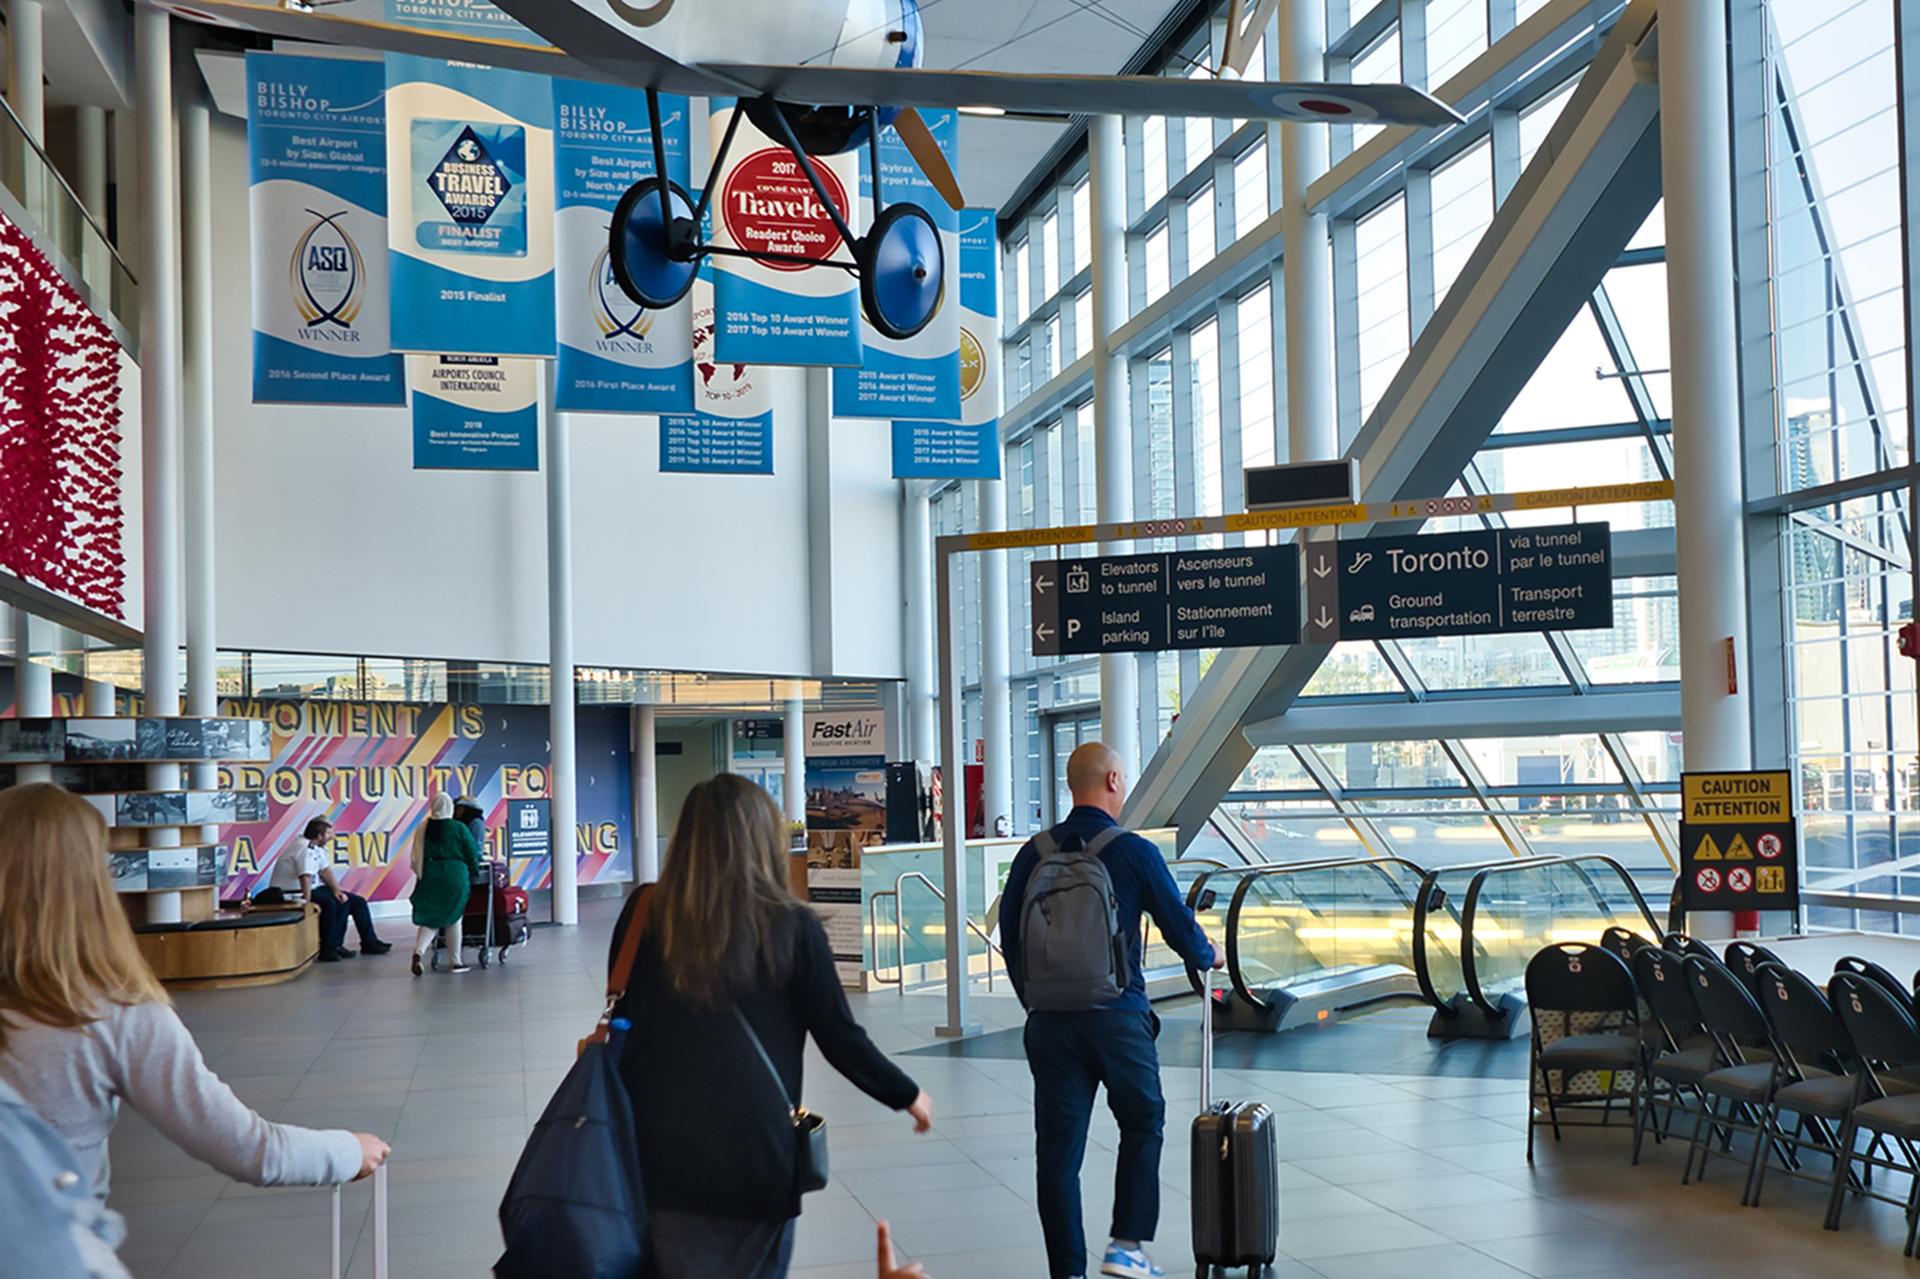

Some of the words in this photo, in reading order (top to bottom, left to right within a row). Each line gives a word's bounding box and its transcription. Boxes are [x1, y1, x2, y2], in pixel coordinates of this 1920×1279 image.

[396, 5, 453, 16] TORONTO
[456, 10, 481, 18] CITY
[258, 82, 308, 97] BILLY
[258, 95, 330, 111] BISHOP
[258, 110, 310, 119] TORONTO
[313, 113, 337, 121] CITY
[560, 104, 606, 119] BILLY
[560, 118, 626, 132] BISHOP
[292, 135, 316, 146] Best
[319, 137, 358, 149] Airport
[560, 131, 608, 141] TORONTO
[611, 134, 633, 142] CITY
[286, 148, 299, 159] by
[329, 151, 364, 162] Global
[443, 162, 495, 176] BUSINESS
[591, 156, 614, 166] Best
[616, 157, 652, 169] Airport
[772, 162, 796, 175] 2017
[575, 168, 587, 178] by
[589, 168, 609, 178] Size
[611, 170, 630, 179] and
[435, 172, 504, 195] TRAVEL
[586, 181, 615, 191] North
[444, 193, 496, 207] AWARDS
[452, 205, 487, 219] 2015
[438, 225, 502, 239] FINALIST
[791, 230, 826, 243] Choice
[767, 241, 805, 254] Awards
[308, 246, 348, 272] ASQ
[440, 290, 465, 300] 2015
[467, 291, 506, 302] Finalist
[727, 312, 749, 322] 2016
[751, 313, 768, 324] Top
[770, 314, 781, 322] 10
[783, 314, 813, 324] Award
[815, 315, 849, 324] Winner
[298, 329, 360, 342] WINNER
[727, 325, 749, 334] 2017
[751, 326, 768, 337] Top
[770, 326, 781, 335] 10
[783, 327, 813, 336] Award
[815, 328, 849, 337] Winner
[596, 340, 654, 354] WINNER
[294, 371, 328, 380] Second
[331, 372, 357, 381] Place
[359, 373, 391, 382] Award
[432, 369, 470, 379] AIRPORTS
[472, 370, 506, 381] COUNCIL
[879, 372, 905, 380] Award
[907, 373, 936, 381] Winner
[440, 381, 501, 392] INTERNATIONAL
[598, 380, 619, 389] First
[621, 382, 645, 391] Place
[647, 383, 676, 392] Award
[879, 383, 905, 391] Award
[907, 384, 936, 392] Winner
[858, 393, 877, 401] 2017
[879, 394, 905, 402] Award
[907, 395, 936, 403] Winner
[430, 430, 448, 438] Best
[450, 431, 489, 439] Innovative
[491, 432, 520, 440] Project
[687, 428, 700, 436] Top
[687, 447, 700, 455] Top
[1526, 490, 1583, 505] CAUTION
[1589, 485, 1664, 499] ATTENTION
[1236, 514, 1286, 527] CAUTION
[1293, 509, 1357, 523] ATTENTION
[977, 535, 1023, 545] CAUTION
[1026, 530, 1085, 542] ATTENTION
[1509, 535, 1531, 549] via
[1535, 531, 1581, 548] tunnel
[1176, 556, 1254, 571] Ascenseurs
[1386, 546, 1489, 574] Toronto
[1510, 557, 1535, 572] par
[1540, 553, 1553, 567] le
[1558, 549, 1604, 566] tunnel
[1101, 562, 1159, 576] Elevators
[1101, 583, 1114, 595] to
[1118, 580, 1157, 594] tunnel
[1177, 578, 1205, 590] vers
[1209, 576, 1220, 588] le
[1225, 572, 1265, 588] tunnel
[1511, 584, 1583, 602] Transport
[1389, 592, 1443, 609] Ground
[1102, 610, 1140, 624] Island
[1177, 603, 1273, 621] Stationnement
[1512, 607, 1575, 623] terrestre
[1390, 611, 1492, 630] transportation
[1067, 618, 1081, 639] P
[1177, 628, 1198, 640] sur
[1102, 629, 1149, 646] parking
[449, 703, 485, 739] IS
[501, 762, 547, 799] FO
[1702, 779, 1771, 794] CAUTION
[1693, 801, 1781, 816] ATTENTION
[228, 834, 261, 876] A
[331, 829, 392, 868] EW
